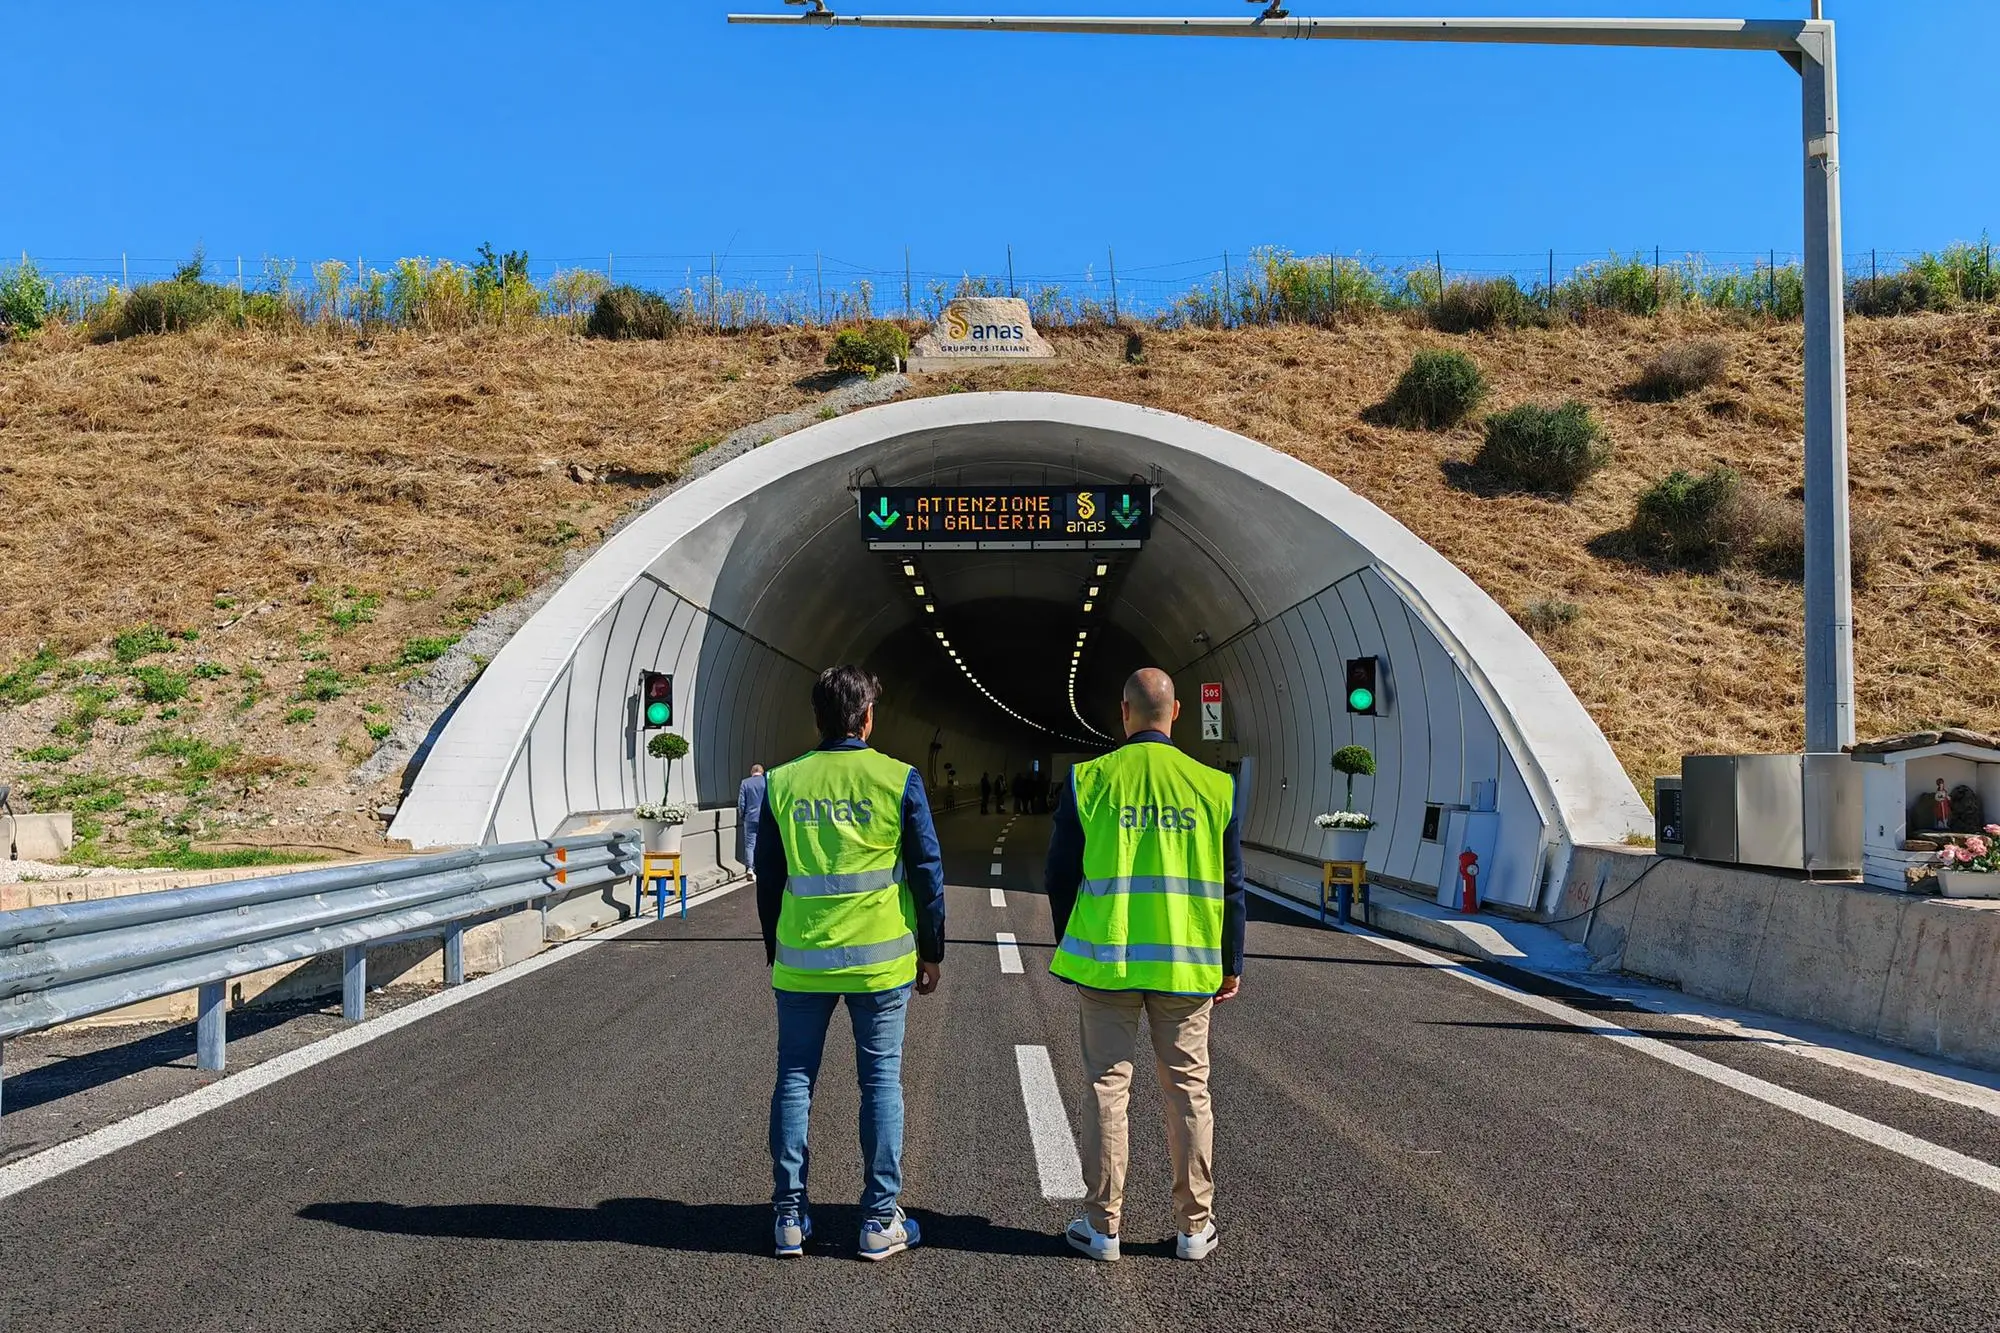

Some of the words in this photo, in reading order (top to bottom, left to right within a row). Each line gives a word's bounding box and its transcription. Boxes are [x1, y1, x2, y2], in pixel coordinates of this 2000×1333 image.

[973, 324, 1024, 340] anas
[917, 496, 1050, 513] ATTENZIONE
[905, 515, 930, 531] IN
[944, 514, 1051, 530] GALLERIA
[1066, 519, 1106, 533] anas
[1204, 689, 1219, 698] SOS
[793, 798, 873, 824] anas
[1119, 804, 1197, 830] anas
[786, 1218, 795, 1227] 19
